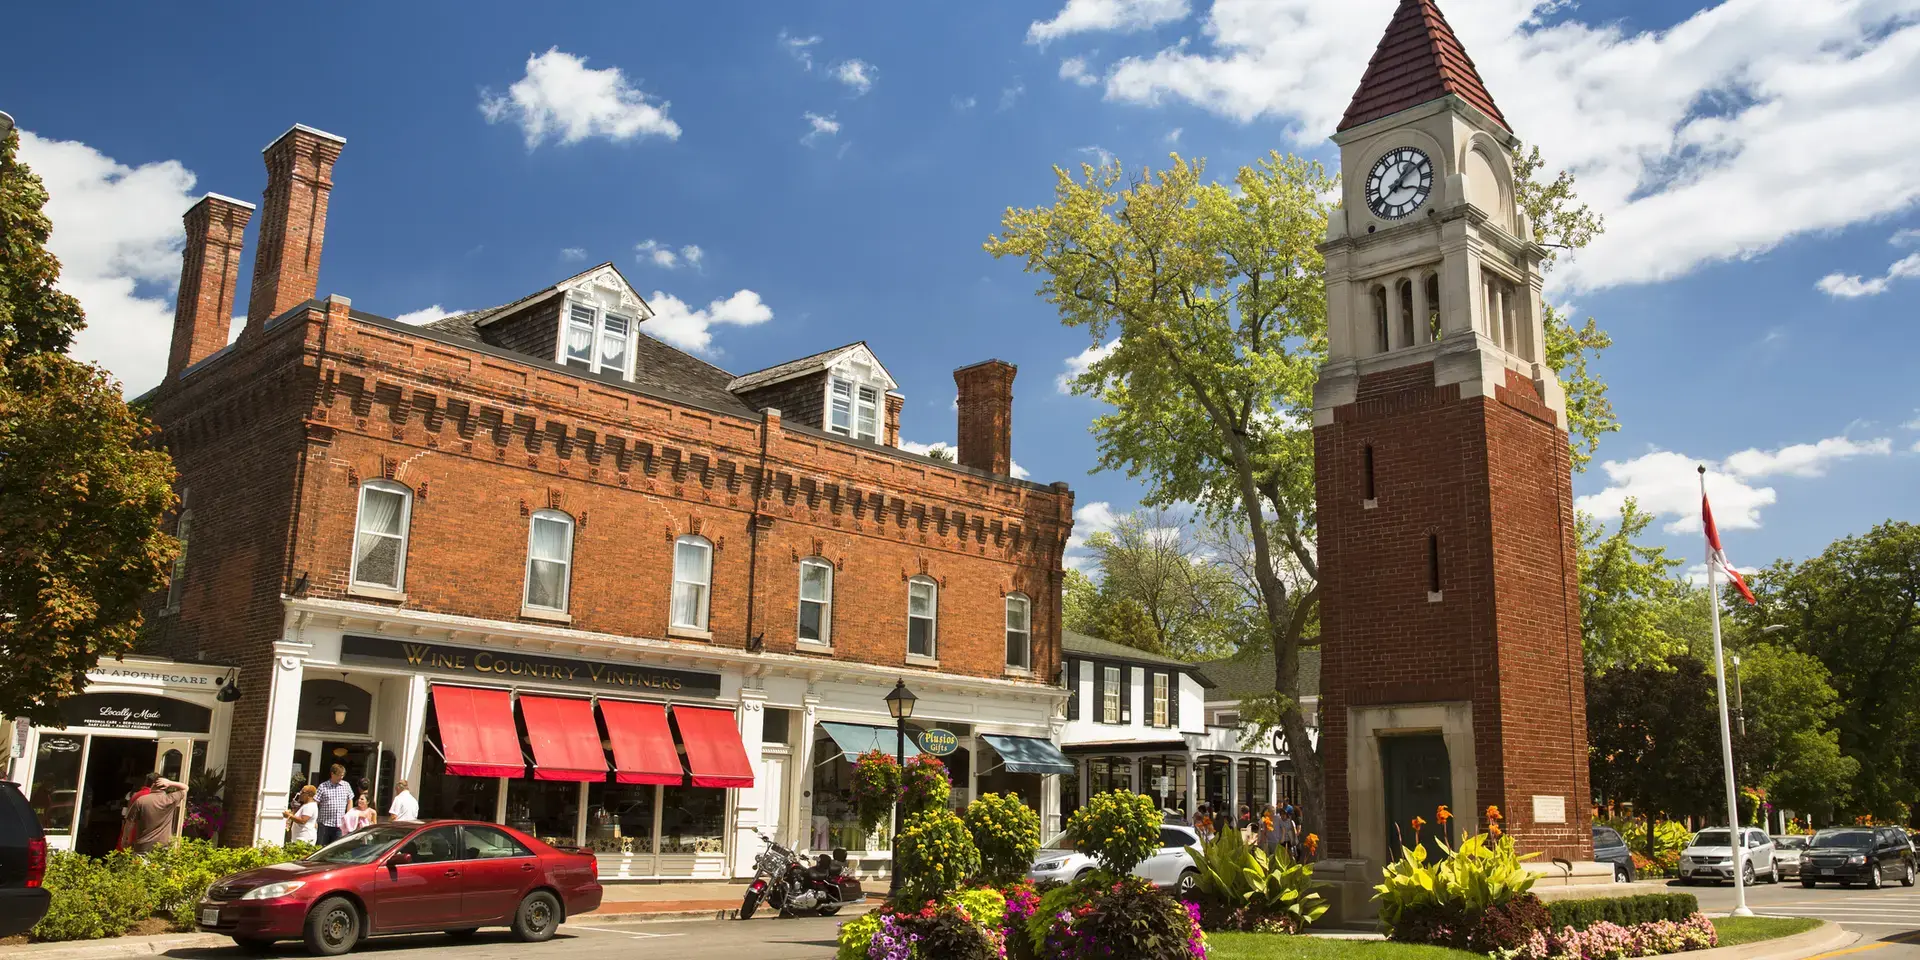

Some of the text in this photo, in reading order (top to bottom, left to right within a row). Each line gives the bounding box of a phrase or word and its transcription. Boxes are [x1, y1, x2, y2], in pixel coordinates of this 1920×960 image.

[401, 643, 682, 690] WINE COUNTRY VINTNERS
[111, 669, 208, 685] APOTHECARE
[100, 706, 161, 720] Locally Made
[925, 732, 955, 744] Plusios
[930, 743, 948, 753] Gifts
